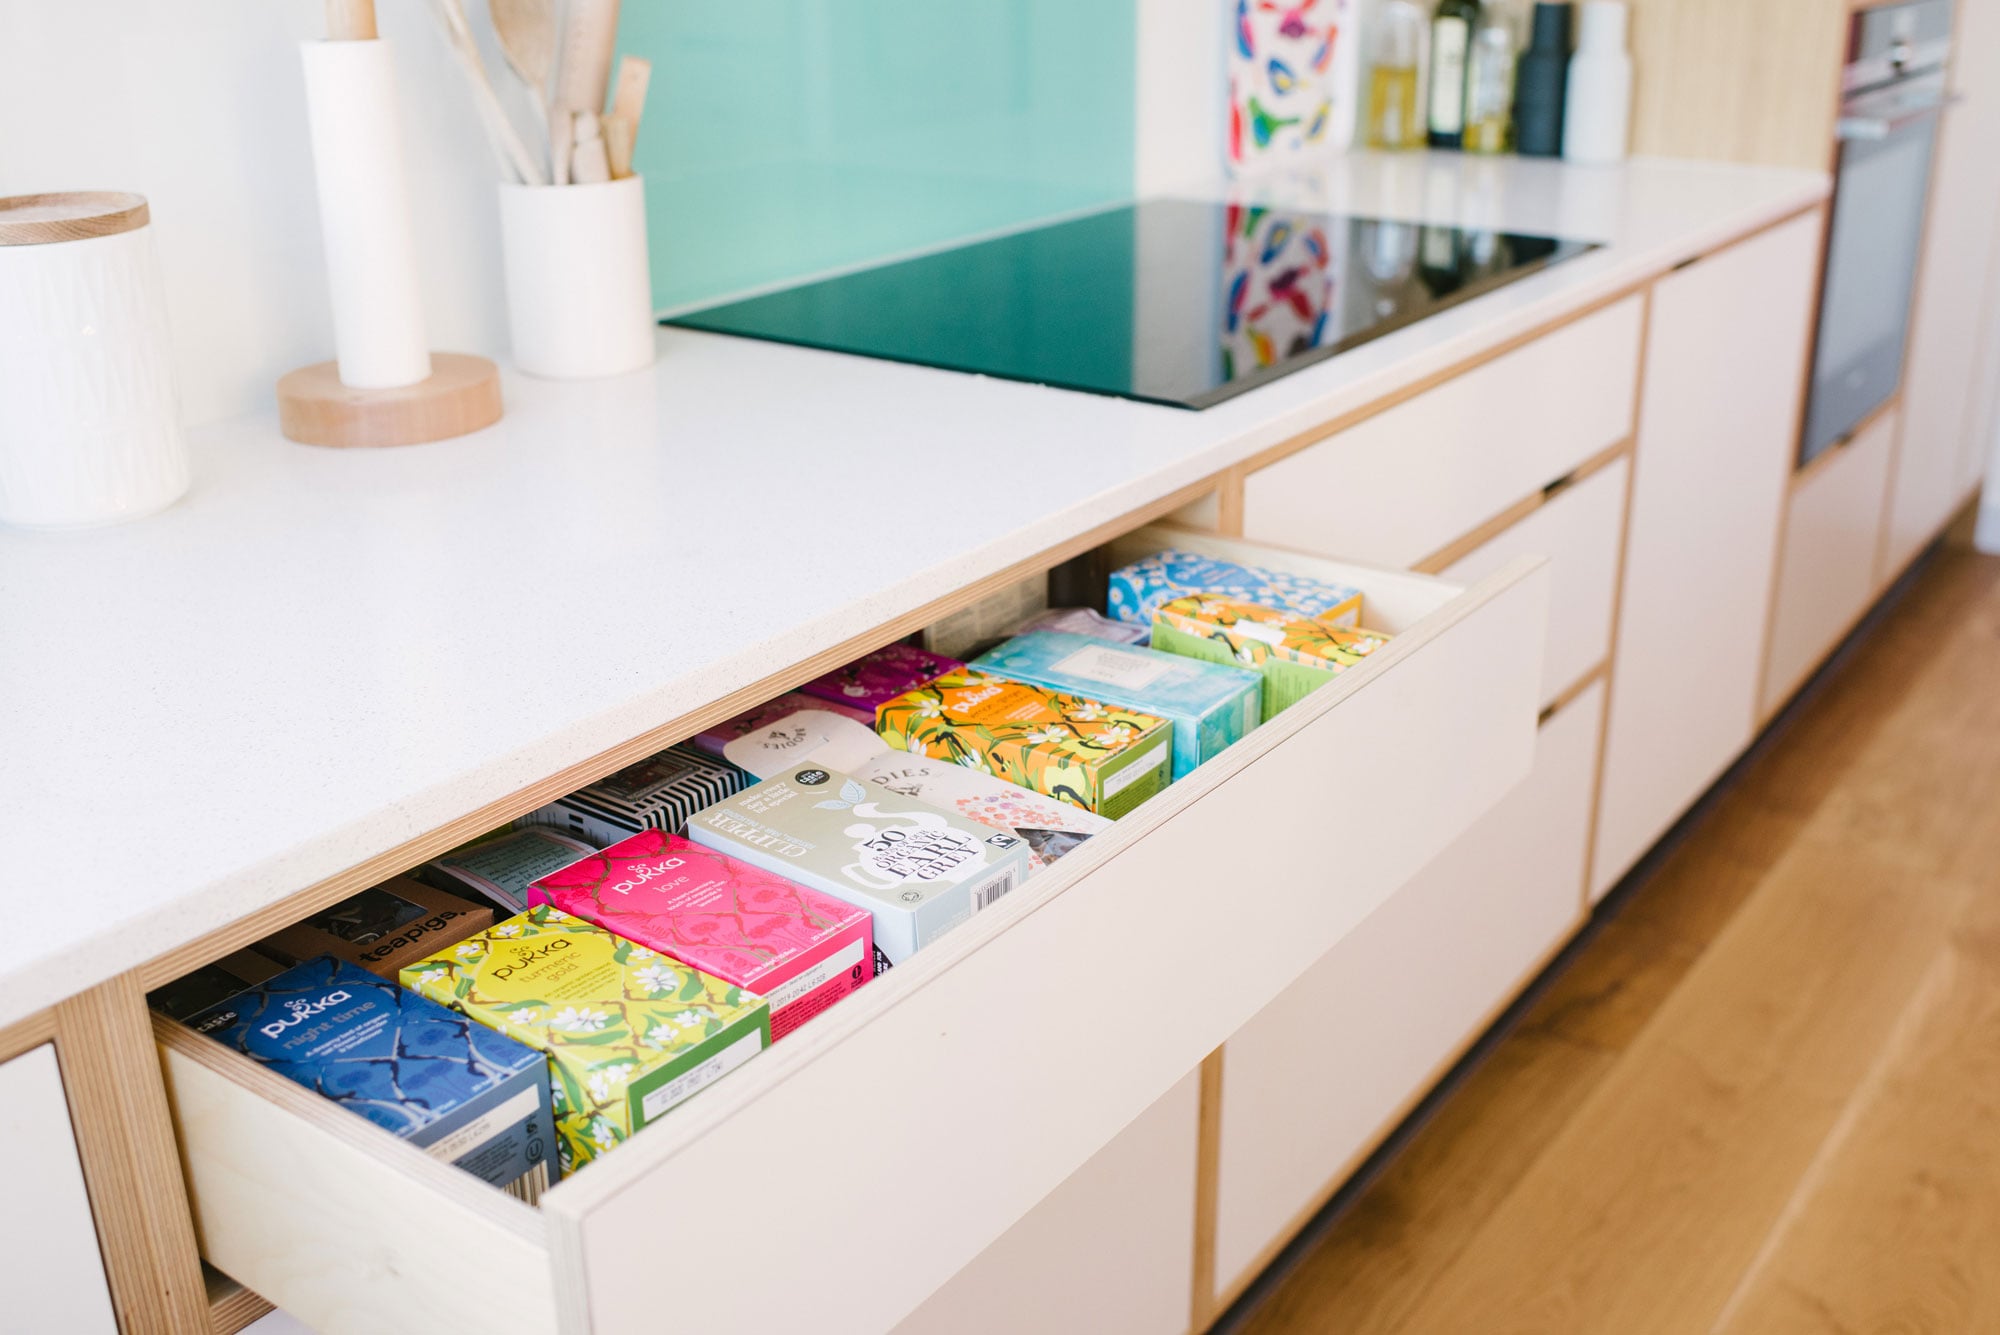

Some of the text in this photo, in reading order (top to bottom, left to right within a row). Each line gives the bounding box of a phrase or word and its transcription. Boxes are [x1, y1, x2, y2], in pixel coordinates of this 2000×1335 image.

[871, 768, 930, 785] DIES
[708, 812, 808, 857] CLIPPER
[862, 830, 906, 852] 50
[876, 830, 945, 869] ORGANIC
[612, 858, 686, 895] pukka
[886, 837, 971, 879] EARL
[917, 846, 979, 880] GREY
[653, 876, 690, 893] love
[360, 911, 466, 962] teapigs.
[491, 939, 573, 981] pukka
[518, 952, 581, 982] turmeric
[547, 963, 579, 982] gold
[260, 990, 353, 1039] pukka
[283, 1002, 376, 1050] night time
